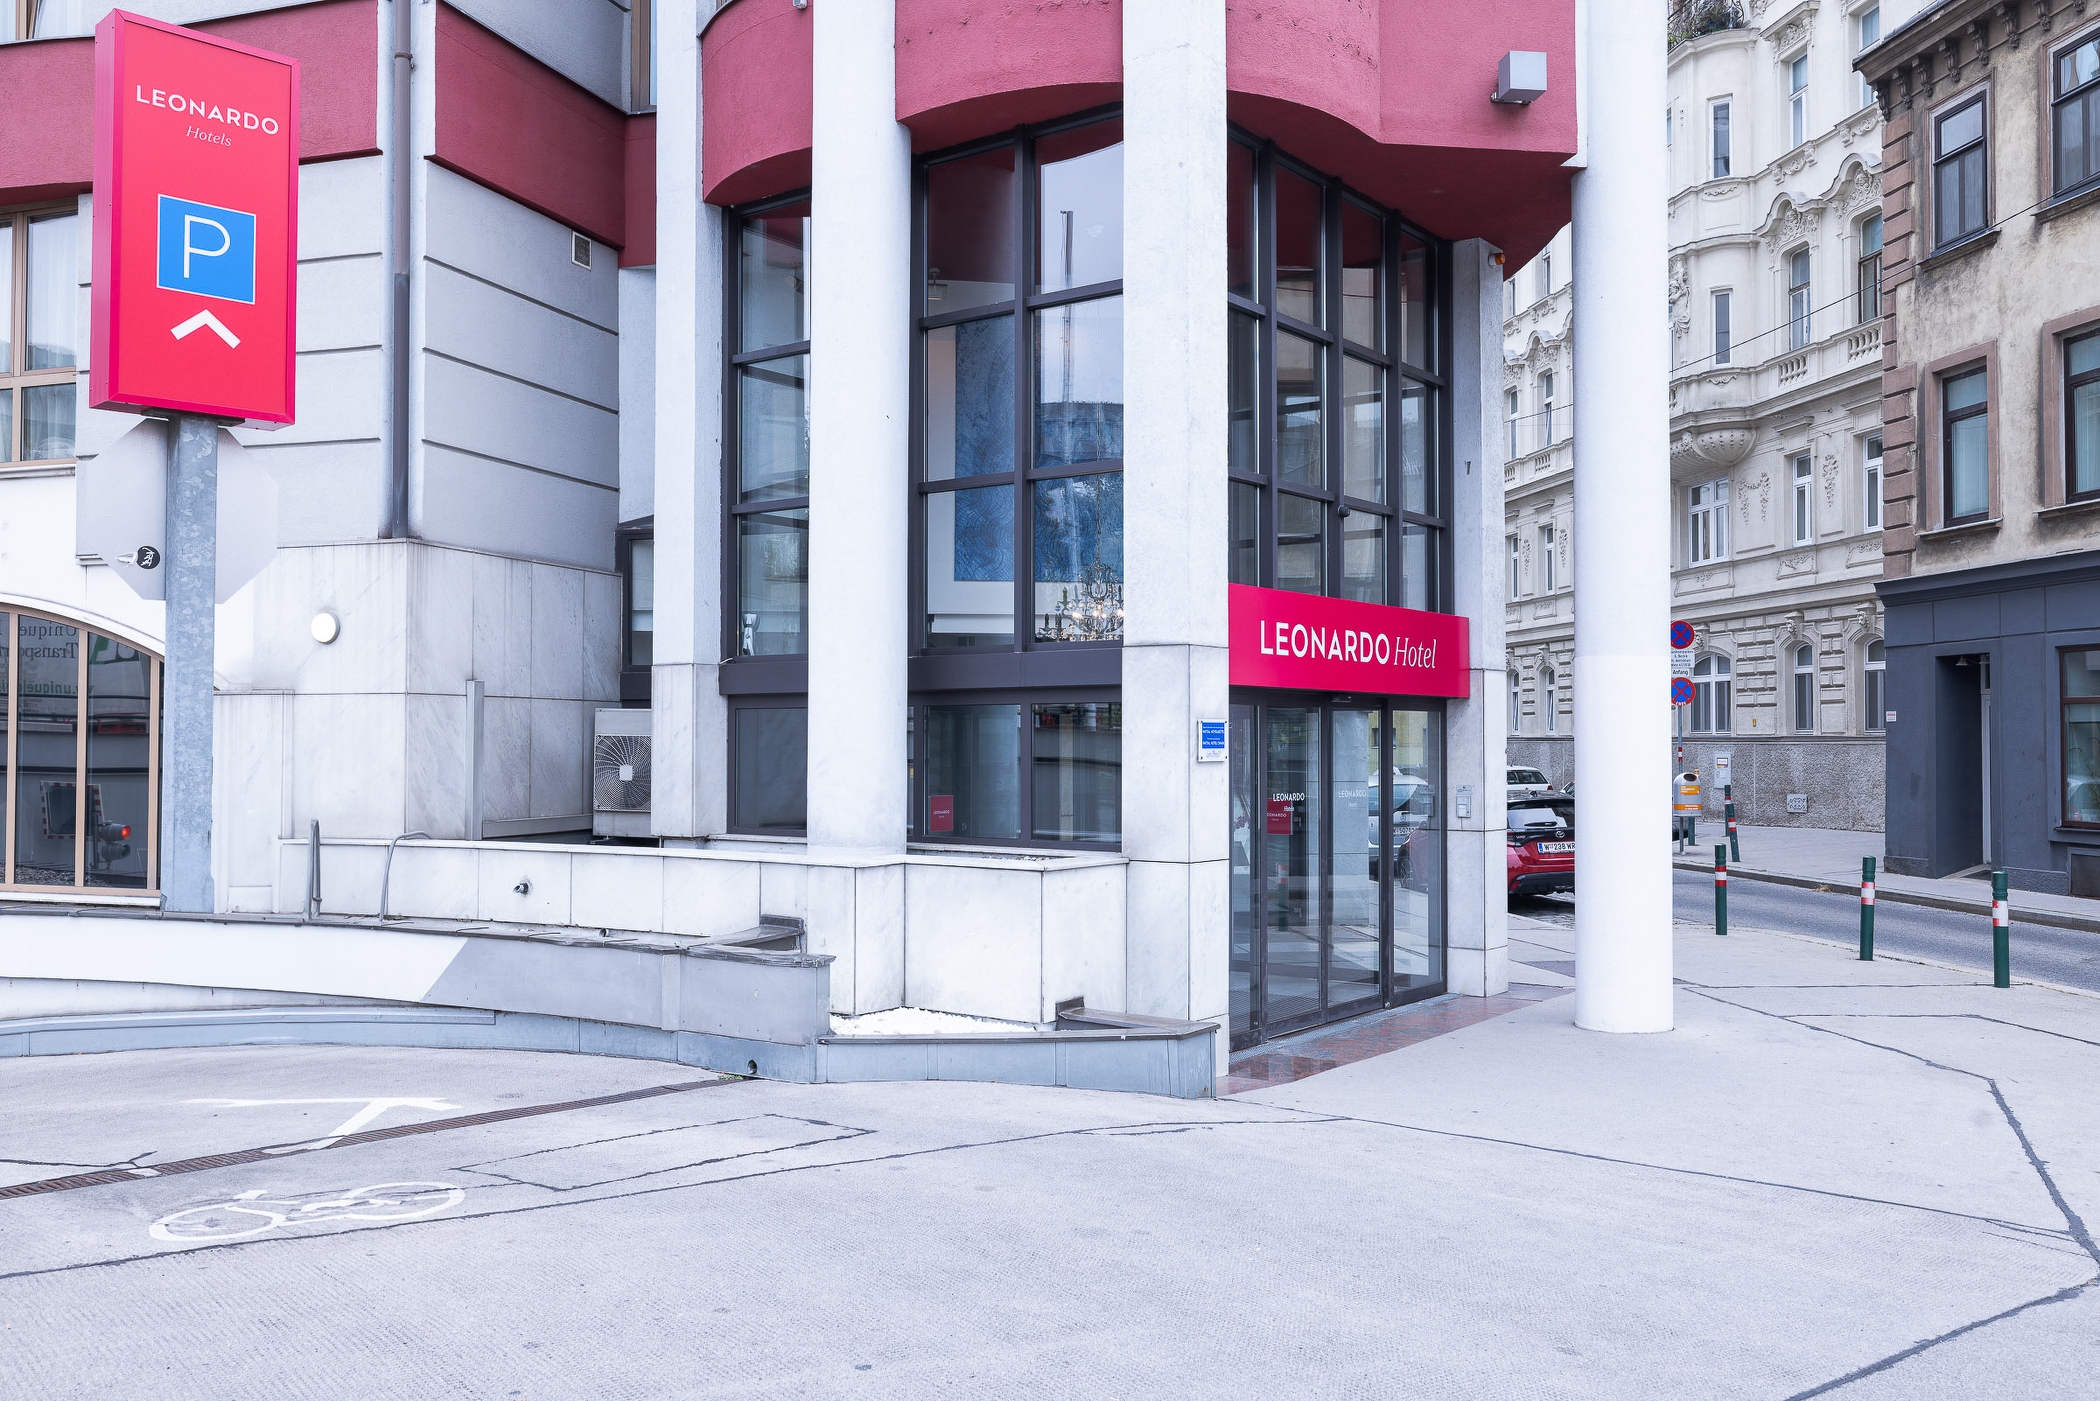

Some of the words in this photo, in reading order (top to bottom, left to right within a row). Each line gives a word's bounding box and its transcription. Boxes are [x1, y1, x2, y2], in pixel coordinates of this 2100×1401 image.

[136, 85, 279, 135] LEONARDO
[186, 126, 232, 147] Hotels
[184, 214, 231, 279] P
[1260, 620, 1390, 665] LEONARDO
[1393, 637, 1437, 669] Hotel
[1272, 792, 1305, 802] LEONARDO
[1338, 790, 1367, 798] LEONARDO
